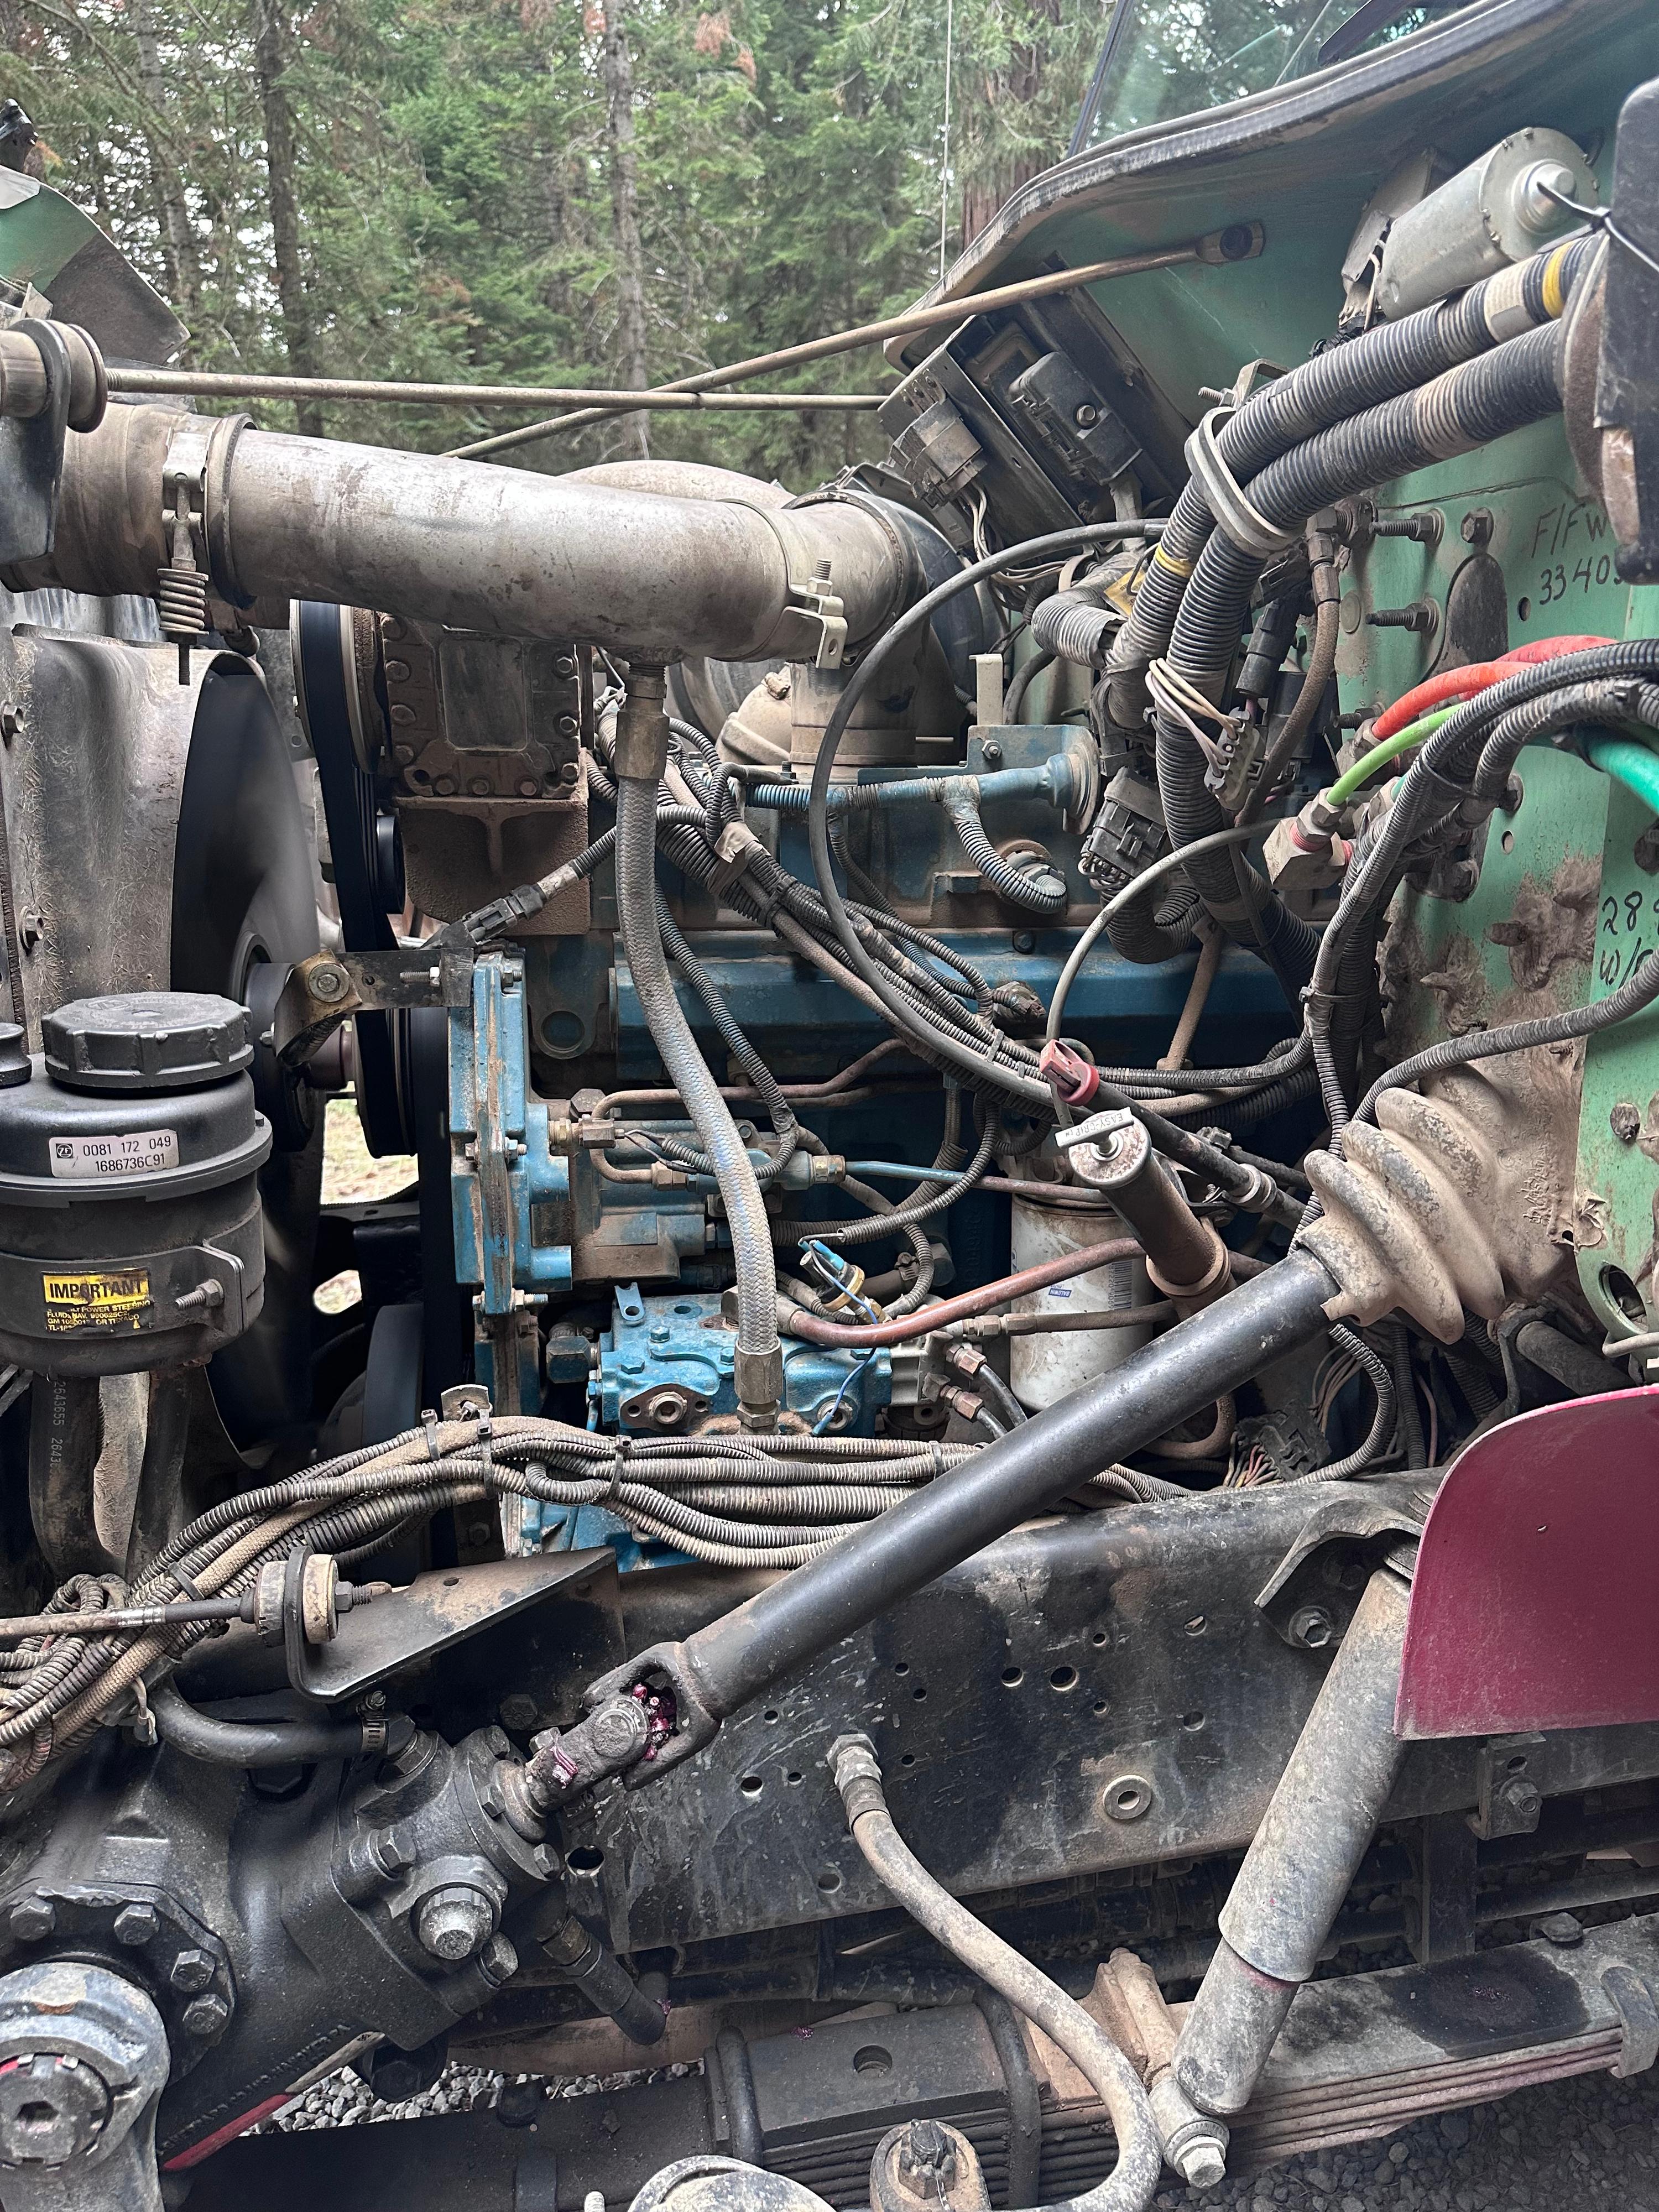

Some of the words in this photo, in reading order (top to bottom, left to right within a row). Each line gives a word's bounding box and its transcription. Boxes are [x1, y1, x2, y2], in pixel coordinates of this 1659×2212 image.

[1540, 555, 1624, 605] 3340
[83, 1144, 111, 1156] 0081
[122, 1141, 139, 1153] 172
[149, 1136, 171, 1150] 049
[96, 1154, 165, 1172] 1686736C91
[50, 1279, 143, 1298] IMPORTANT
[112, 1300, 150, 1311] STEERING
[53, 1382, 66, 1426] 2643655
